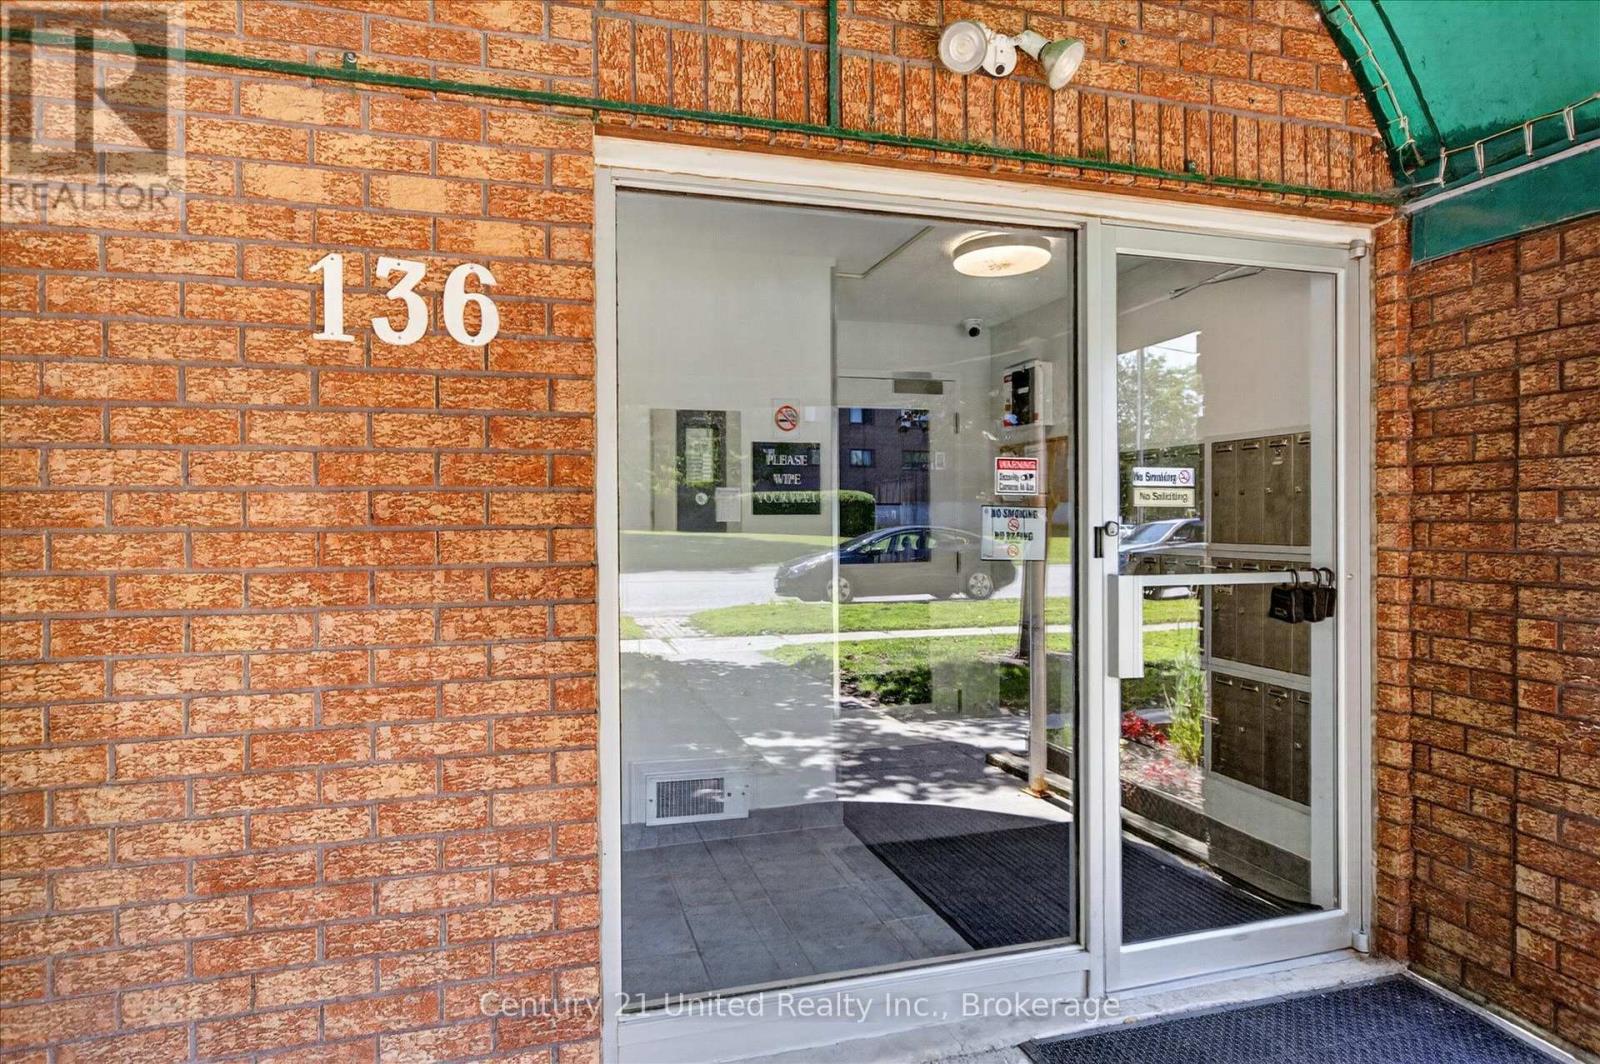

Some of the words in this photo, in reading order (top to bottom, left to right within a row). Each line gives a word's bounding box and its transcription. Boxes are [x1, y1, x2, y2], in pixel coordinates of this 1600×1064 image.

[308, 252, 500, 347] 136
[765, 454, 808, 466] PLEASE
[998, 460, 1036, 469] WARNING
[773, 473, 802, 485] WIPE
[1134, 472, 1144, 482] No
[1145, 471, 1177, 484] Smoking
[1140, 492, 1151, 500] No
[1152, 492, 1188, 503] Soliciting
[991, 508, 1001, 518] NO
[1003, 508, 1039, 519] SMOKING
[994, 531, 1005, 540] NO
[1006, 531, 1034, 541] VAPING
